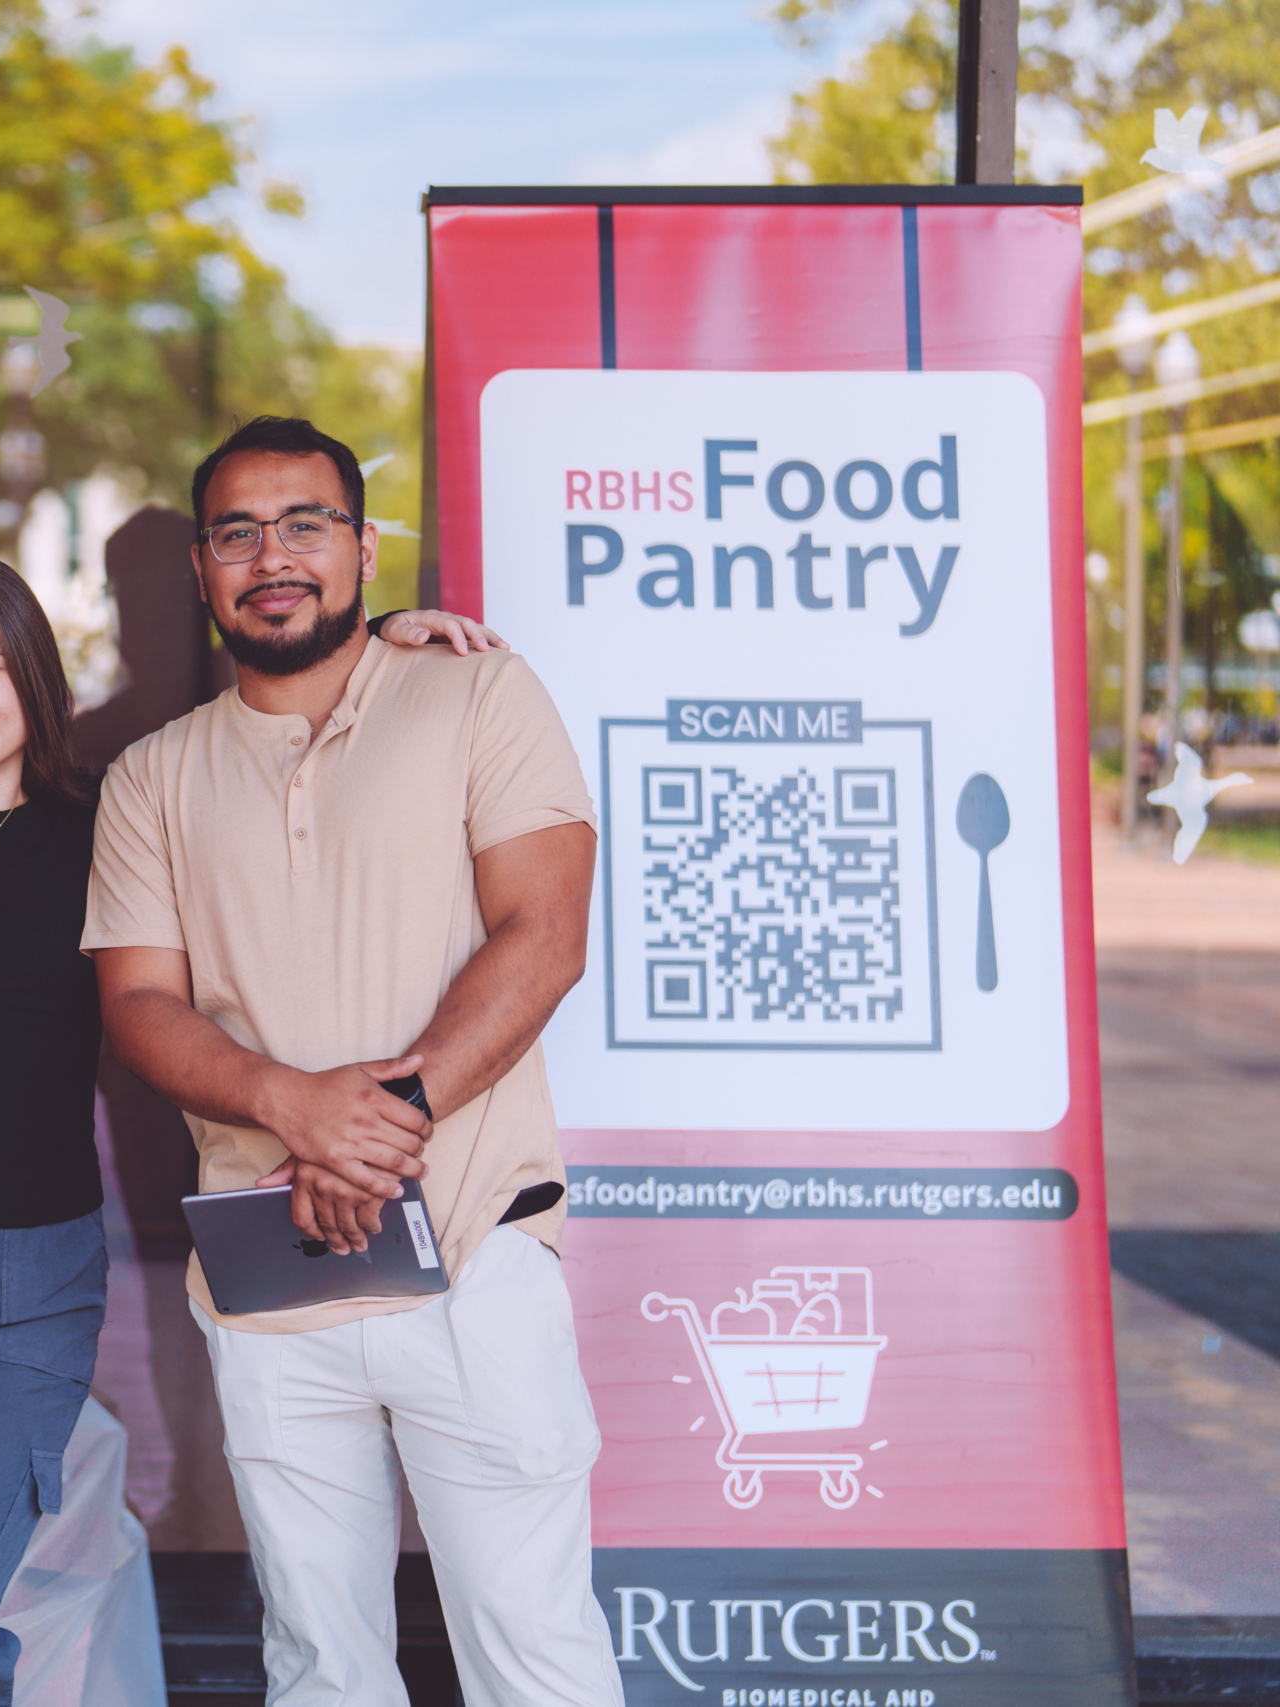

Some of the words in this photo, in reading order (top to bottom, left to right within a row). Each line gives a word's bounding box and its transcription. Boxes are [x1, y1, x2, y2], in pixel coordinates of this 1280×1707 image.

[565, 469, 695, 512] RBHS
[702, 432, 961, 521] Food
[565, 522, 962, 639] Pantry
[679, 704, 786, 738] SCAN
[797, 706, 850, 738] ME
[567, 1175, 1062, 1215] sfoodpantry@rbhs.rutgers.edu
[613, 1587, 980, 1691] RUTGERS
[722, 1689, 876, 1707] BIOMEDICAL
[885, 1689, 936, 1707] AND
